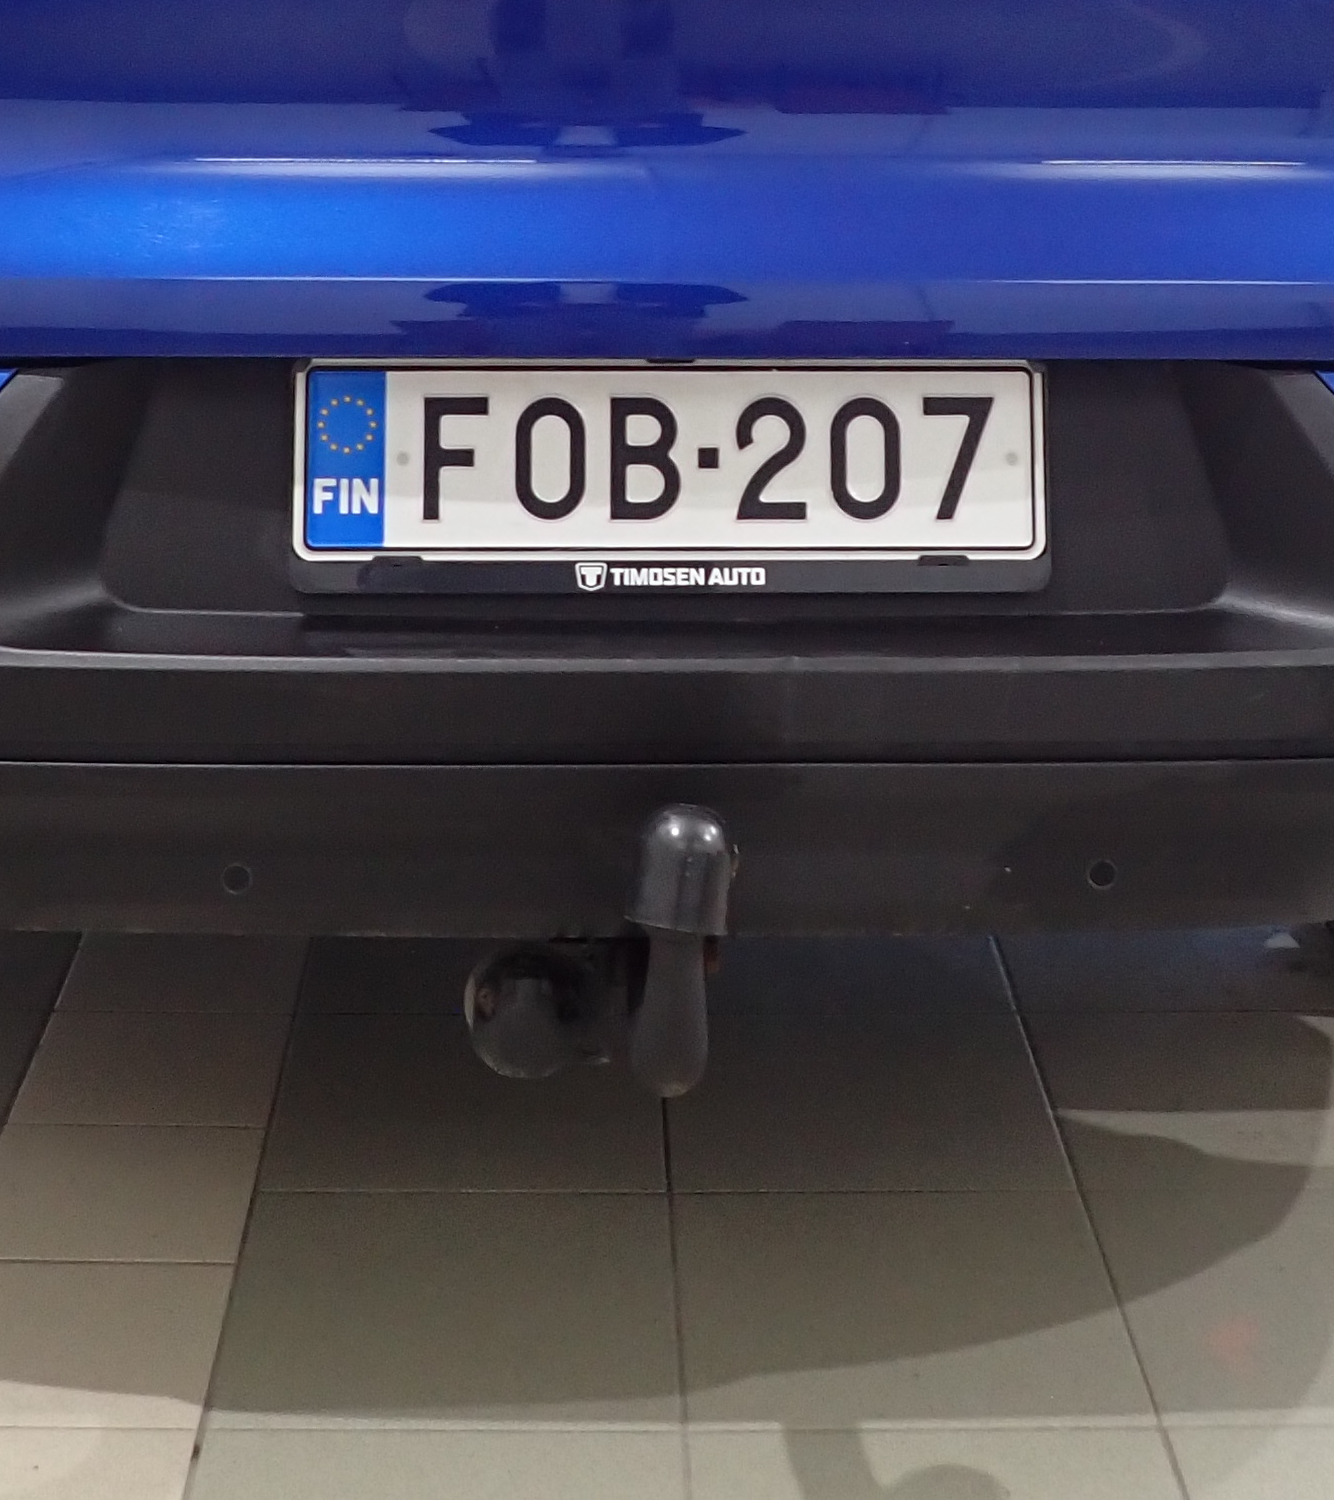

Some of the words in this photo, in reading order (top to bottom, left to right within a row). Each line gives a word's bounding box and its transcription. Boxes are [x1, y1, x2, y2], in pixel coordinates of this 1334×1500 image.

[312, 478, 379, 515] FIN
[610, 567, 706, 586] TIMOSEN
[708, 567, 766, 586] AUTO
